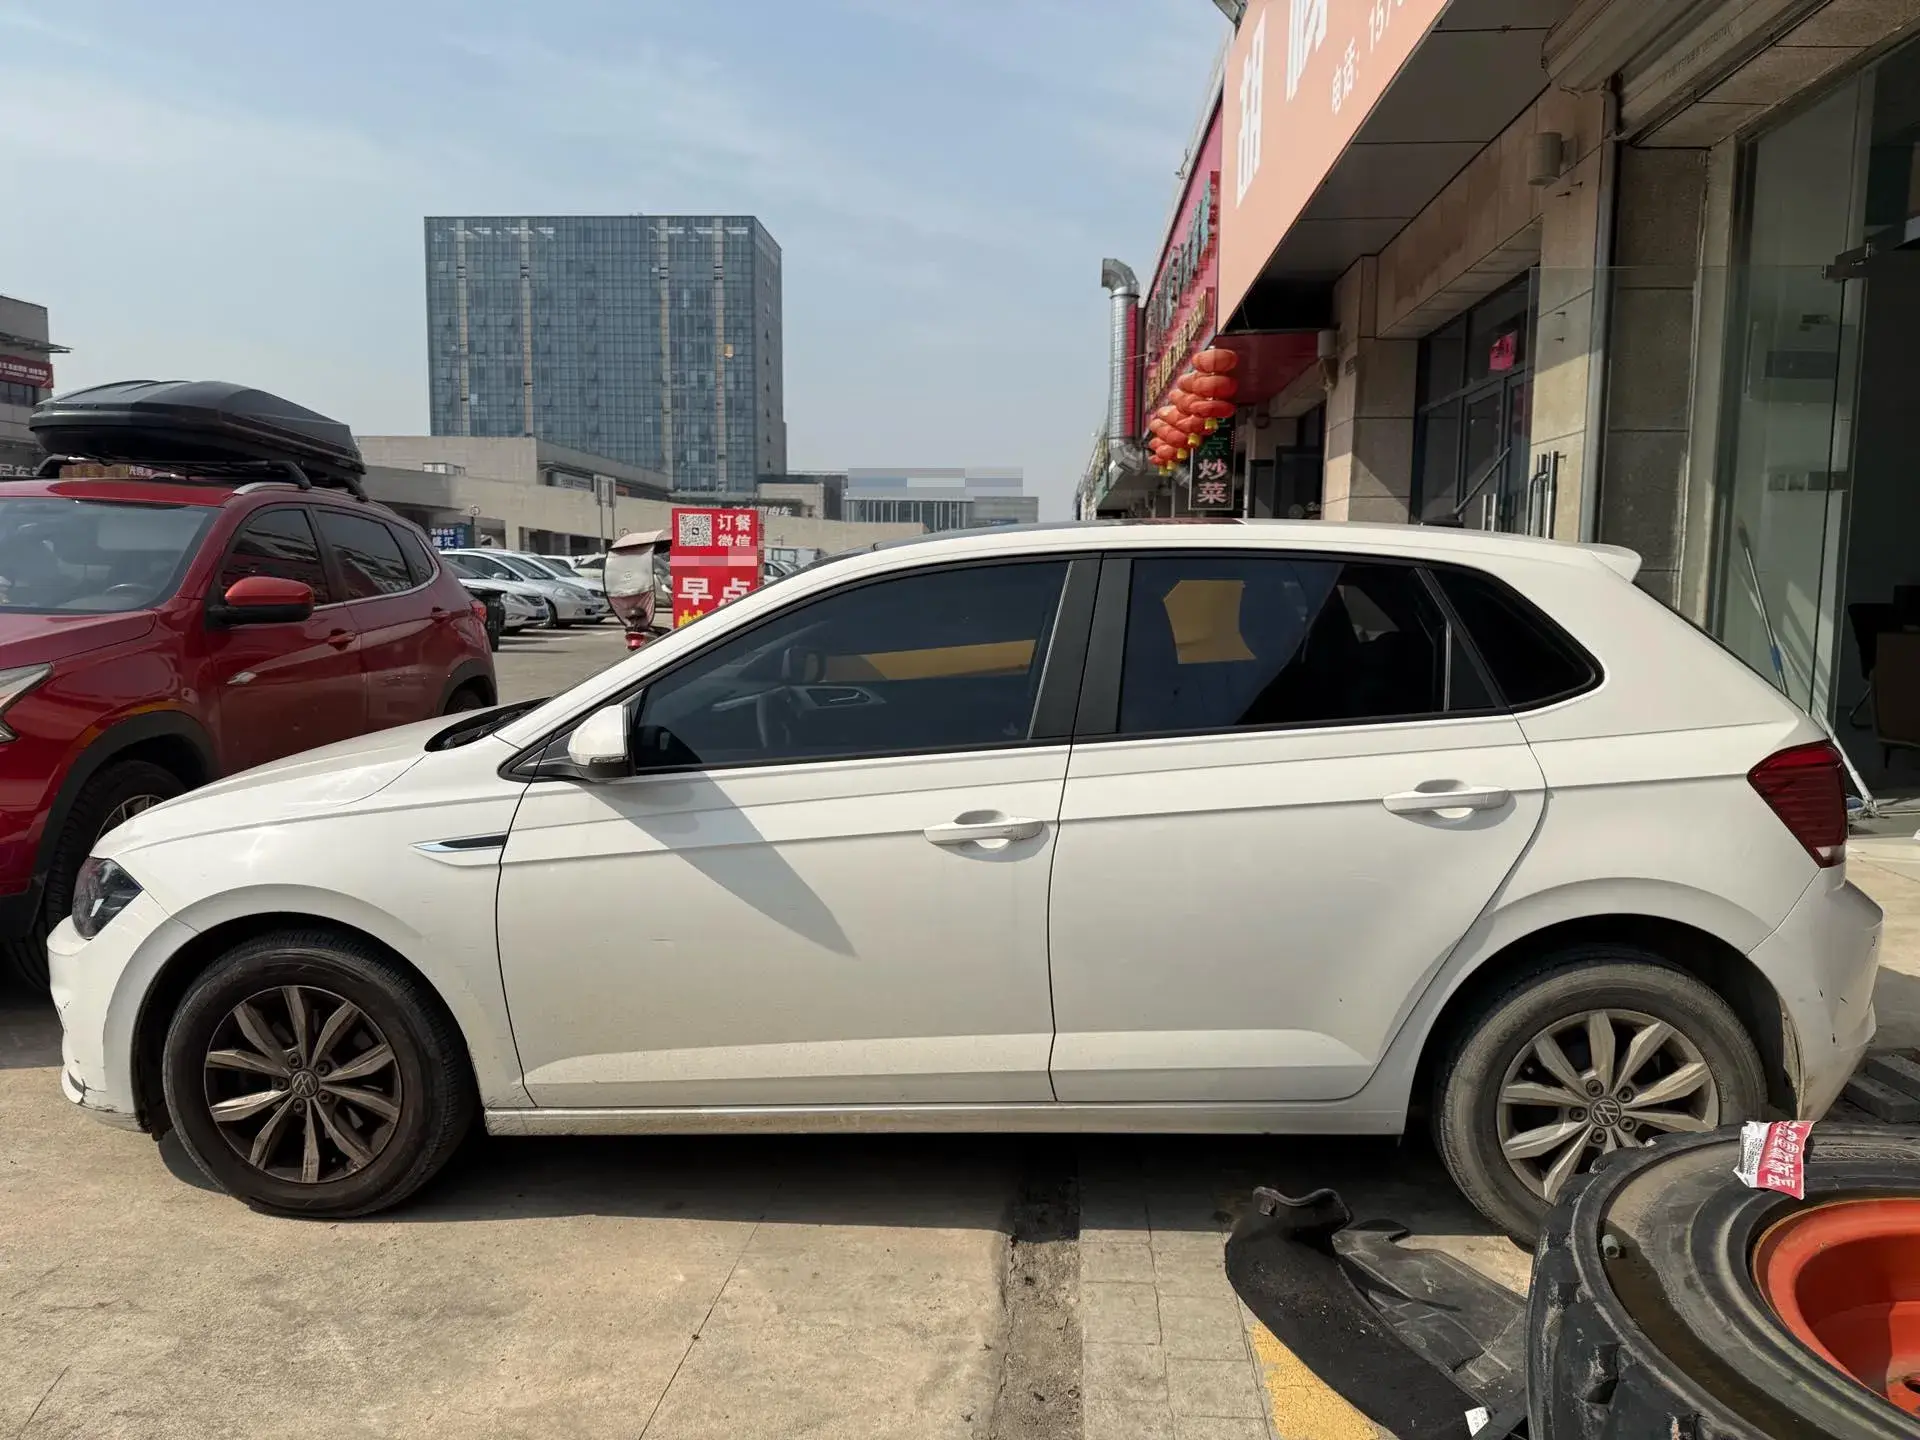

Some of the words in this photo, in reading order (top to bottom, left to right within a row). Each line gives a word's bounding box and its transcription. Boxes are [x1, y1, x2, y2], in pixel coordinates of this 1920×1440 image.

[1369, 0, 1404, 53] 157
[718, 514, 751, 531] 订餐
[718, 534, 751, 547] 微信
[677, 577, 751, 607] 早点
